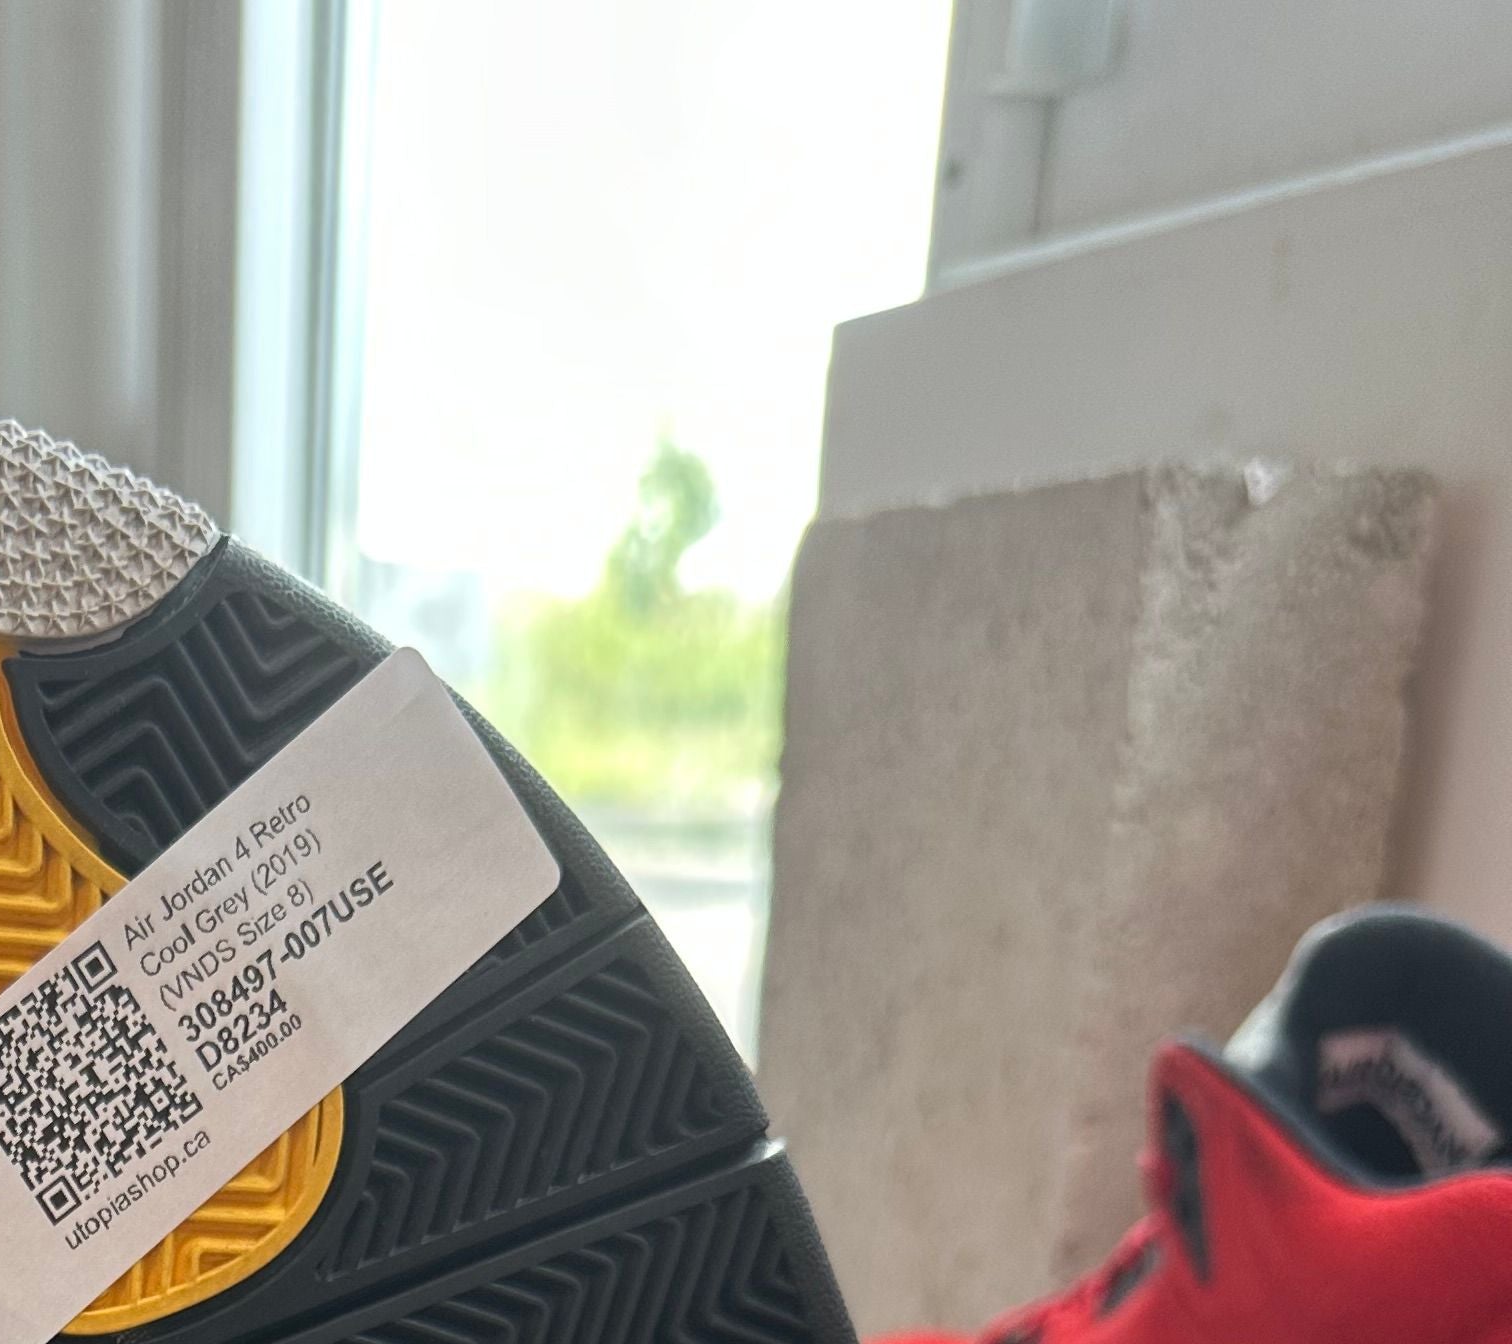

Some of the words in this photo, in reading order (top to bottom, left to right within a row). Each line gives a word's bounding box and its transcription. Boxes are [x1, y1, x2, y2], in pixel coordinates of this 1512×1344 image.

[124, 913, 156, 950] Air
[160, 857, 234, 921] Jordan
[235, 837, 251, 861] 4
[249, 795, 311, 848] Retro
[140, 923, 196, 976] Cool
[195, 887, 249, 933] Grey
[251, 829, 321, 895] (2019)
[160, 939, 236, 1011] (VNDS
[237, 902, 287, 946] Size
[287, 879, 314, 904] 8)
[178, 861, 394, 1042] 308497-007USE
[195, 988, 288, 1072] D8234
[212, 1014, 302, 1090] CA$400.00
[65, 1131, 211, 1250] utopiashop.ca
